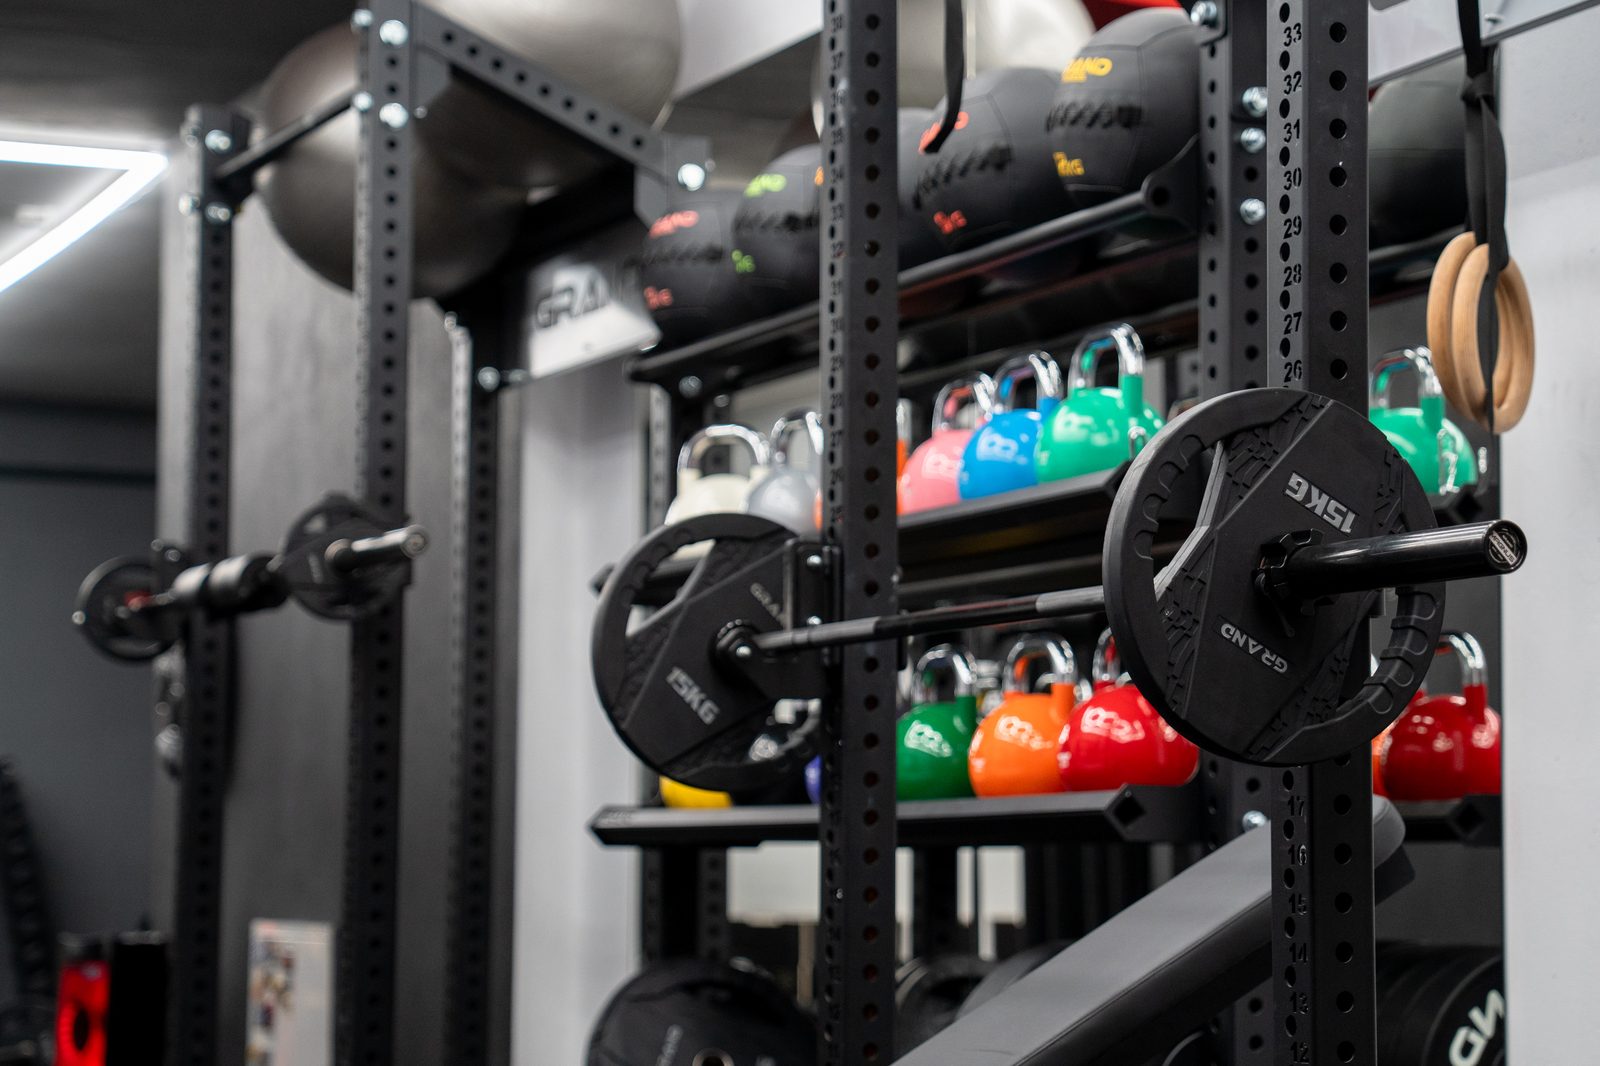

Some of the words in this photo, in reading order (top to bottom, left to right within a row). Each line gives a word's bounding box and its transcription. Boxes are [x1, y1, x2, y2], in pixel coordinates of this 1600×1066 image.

[1283, 22, 1302, 47] 33
[1283, 70, 1302, 95] 32
[1283, 118, 1300, 143] 31
[1283, 167, 1302, 191] 30
[1283, 215, 1302, 239] 29
[1283, 263, 1302, 287] 28
[1283, 311, 1303, 335] 27
[1283, 359, 1302, 383] 26
[1285, 472, 1356, 533] 15KG
[1220, 623, 1288, 673] GRAND
[665, 666, 720, 725] 15KG
[1287, 795, 1305, 816] 17
[1287, 843, 1307, 866] 16
[1288, 893, 1308, 915] 15
[1289, 942, 1308, 964] 14
[1289, 991, 1309, 1014] 13
[1290, 1041, 1310, 1064] 12
